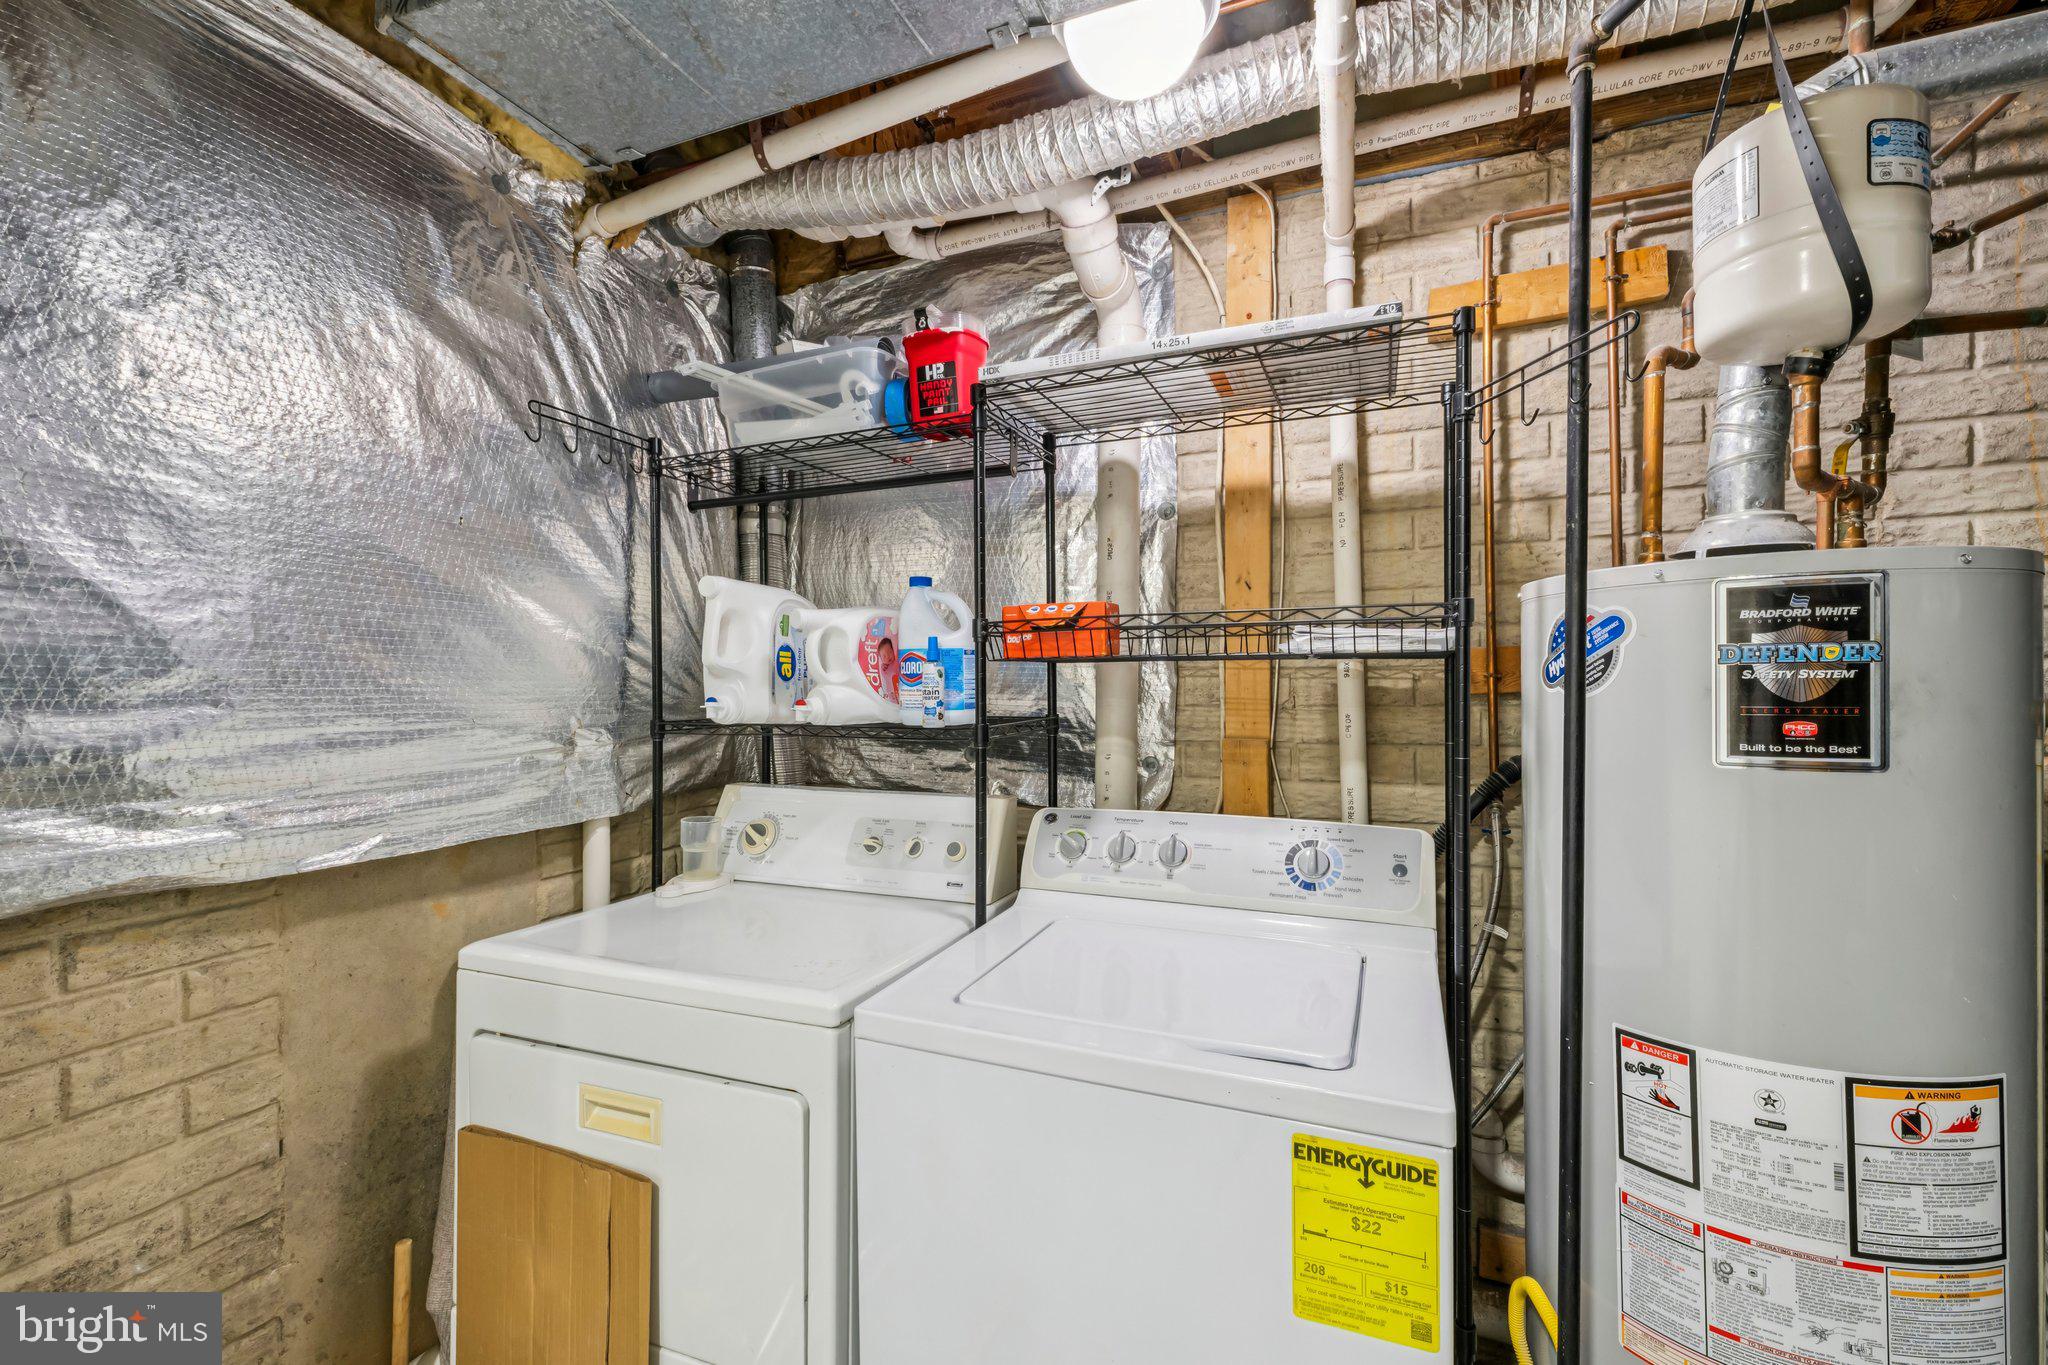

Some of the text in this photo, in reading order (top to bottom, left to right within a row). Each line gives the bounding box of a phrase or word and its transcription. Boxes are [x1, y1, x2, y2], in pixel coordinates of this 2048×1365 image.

[1638, 71, 1662, 85] CORE
[1668, 61, 1713, 78] PVC-DWV
[1544, 92, 1572, 105] 40 CO
[1172, 188, 1182, 196] 40
[1204, 174, 1239, 188] CELLULAR
[1242, 167, 1260, 178] CORE
[1298, 154, 1316, 164] PIPE
[944, 244, 958, 252] CORE
[988, 232, 1000, 240] PIPE
[982, 366, 1000, 376] HDX
[920, 378, 952, 392] HANDY
[922, 387, 951, 400] PAINT
[927, 396, 948, 407] PAIL
[1336, 462, 1344, 502] PRESSURE
[1739, 606, 1860, 620] BRADFORD WHITE
[1748, 616, 1850, 624] CORPORATION
[1718, 642, 1884, 665] DEFENDER
[779, 651, 792, 678] all
[864, 639, 880, 686] dreft
[900, 662, 922, 674] CLORO
[1741, 668, 1856, 681] SAFETY SYSTEM
[1741, 707, 1860, 716] ENERGY SAVER
[1739, 743, 1765, 752] Built
[1768, 744, 1782, 752] to
[1785, 744, 1802, 754] be
[1804, 744, 1826, 754] the
[1114, 816, 1144, 824] Temperature
[1642, 1044, 1680, 1062] DANGER
[1704, 1057, 1836, 1086] AUTOMATIC STORAGE WATER HEATER
[1653, 1080, 1668, 1090] HOT
[1918, 1092, 1962, 1100] WARNING
[1294, 1142, 1437, 1188] ENERGYGUIDE
[1323, 1198, 1348, 1208] Estimated
[1348, 1203, 1365, 1212] Yearly
[1366, 1206, 1392, 1218] Operating
[1392, 1212, 1405, 1220] Cost
[1351, 1216, 1382, 1236] $22
[1756, 1240, 1792, 1256] OPERATING
[1304, 1262, 1326, 1276] 208
[1306, 1286, 1316, 1294] Your
[1318, 1289, 1328, 1297] cost
[1384, 1281, 1408, 1296] $15
[1758, 1344, 1774, 1354] TURN
